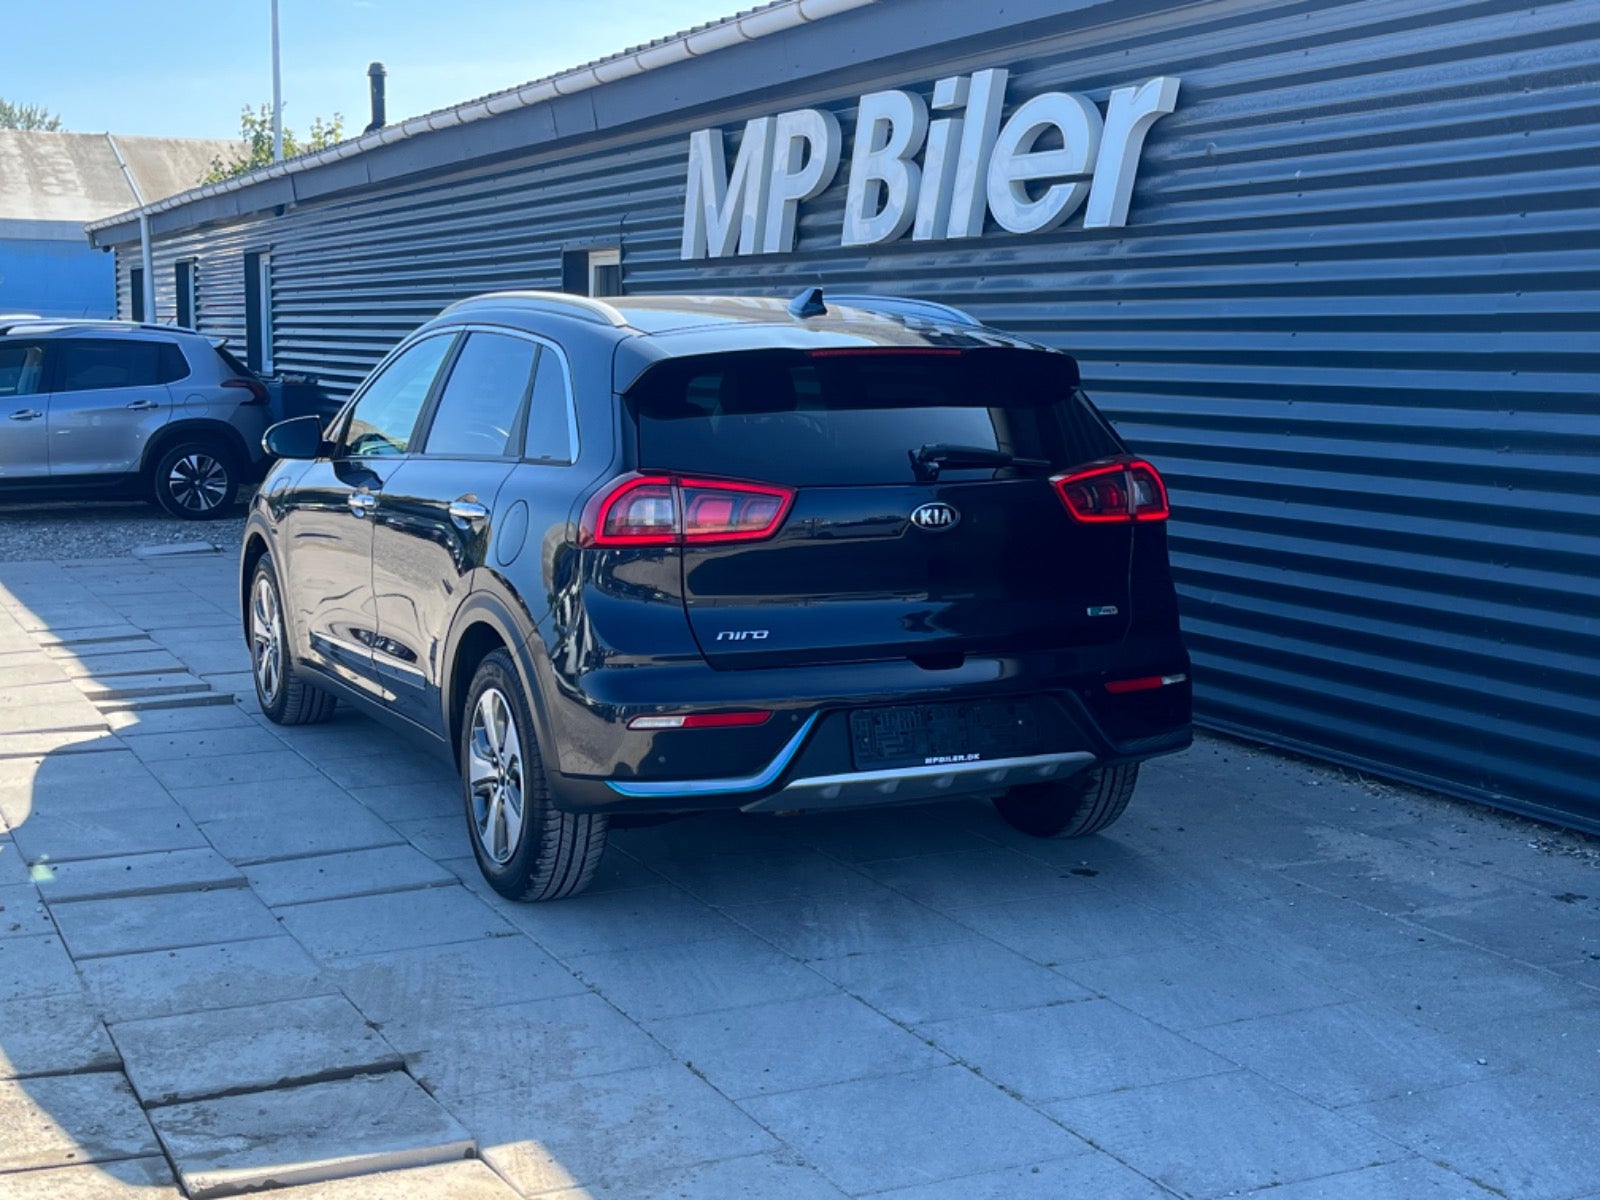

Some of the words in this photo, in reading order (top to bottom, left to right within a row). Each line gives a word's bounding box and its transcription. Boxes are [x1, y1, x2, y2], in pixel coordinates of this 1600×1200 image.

[680, 108, 842, 260] MP
[841, 68, 1181, 246] Biler
[920, 508, 952, 525] KIA
